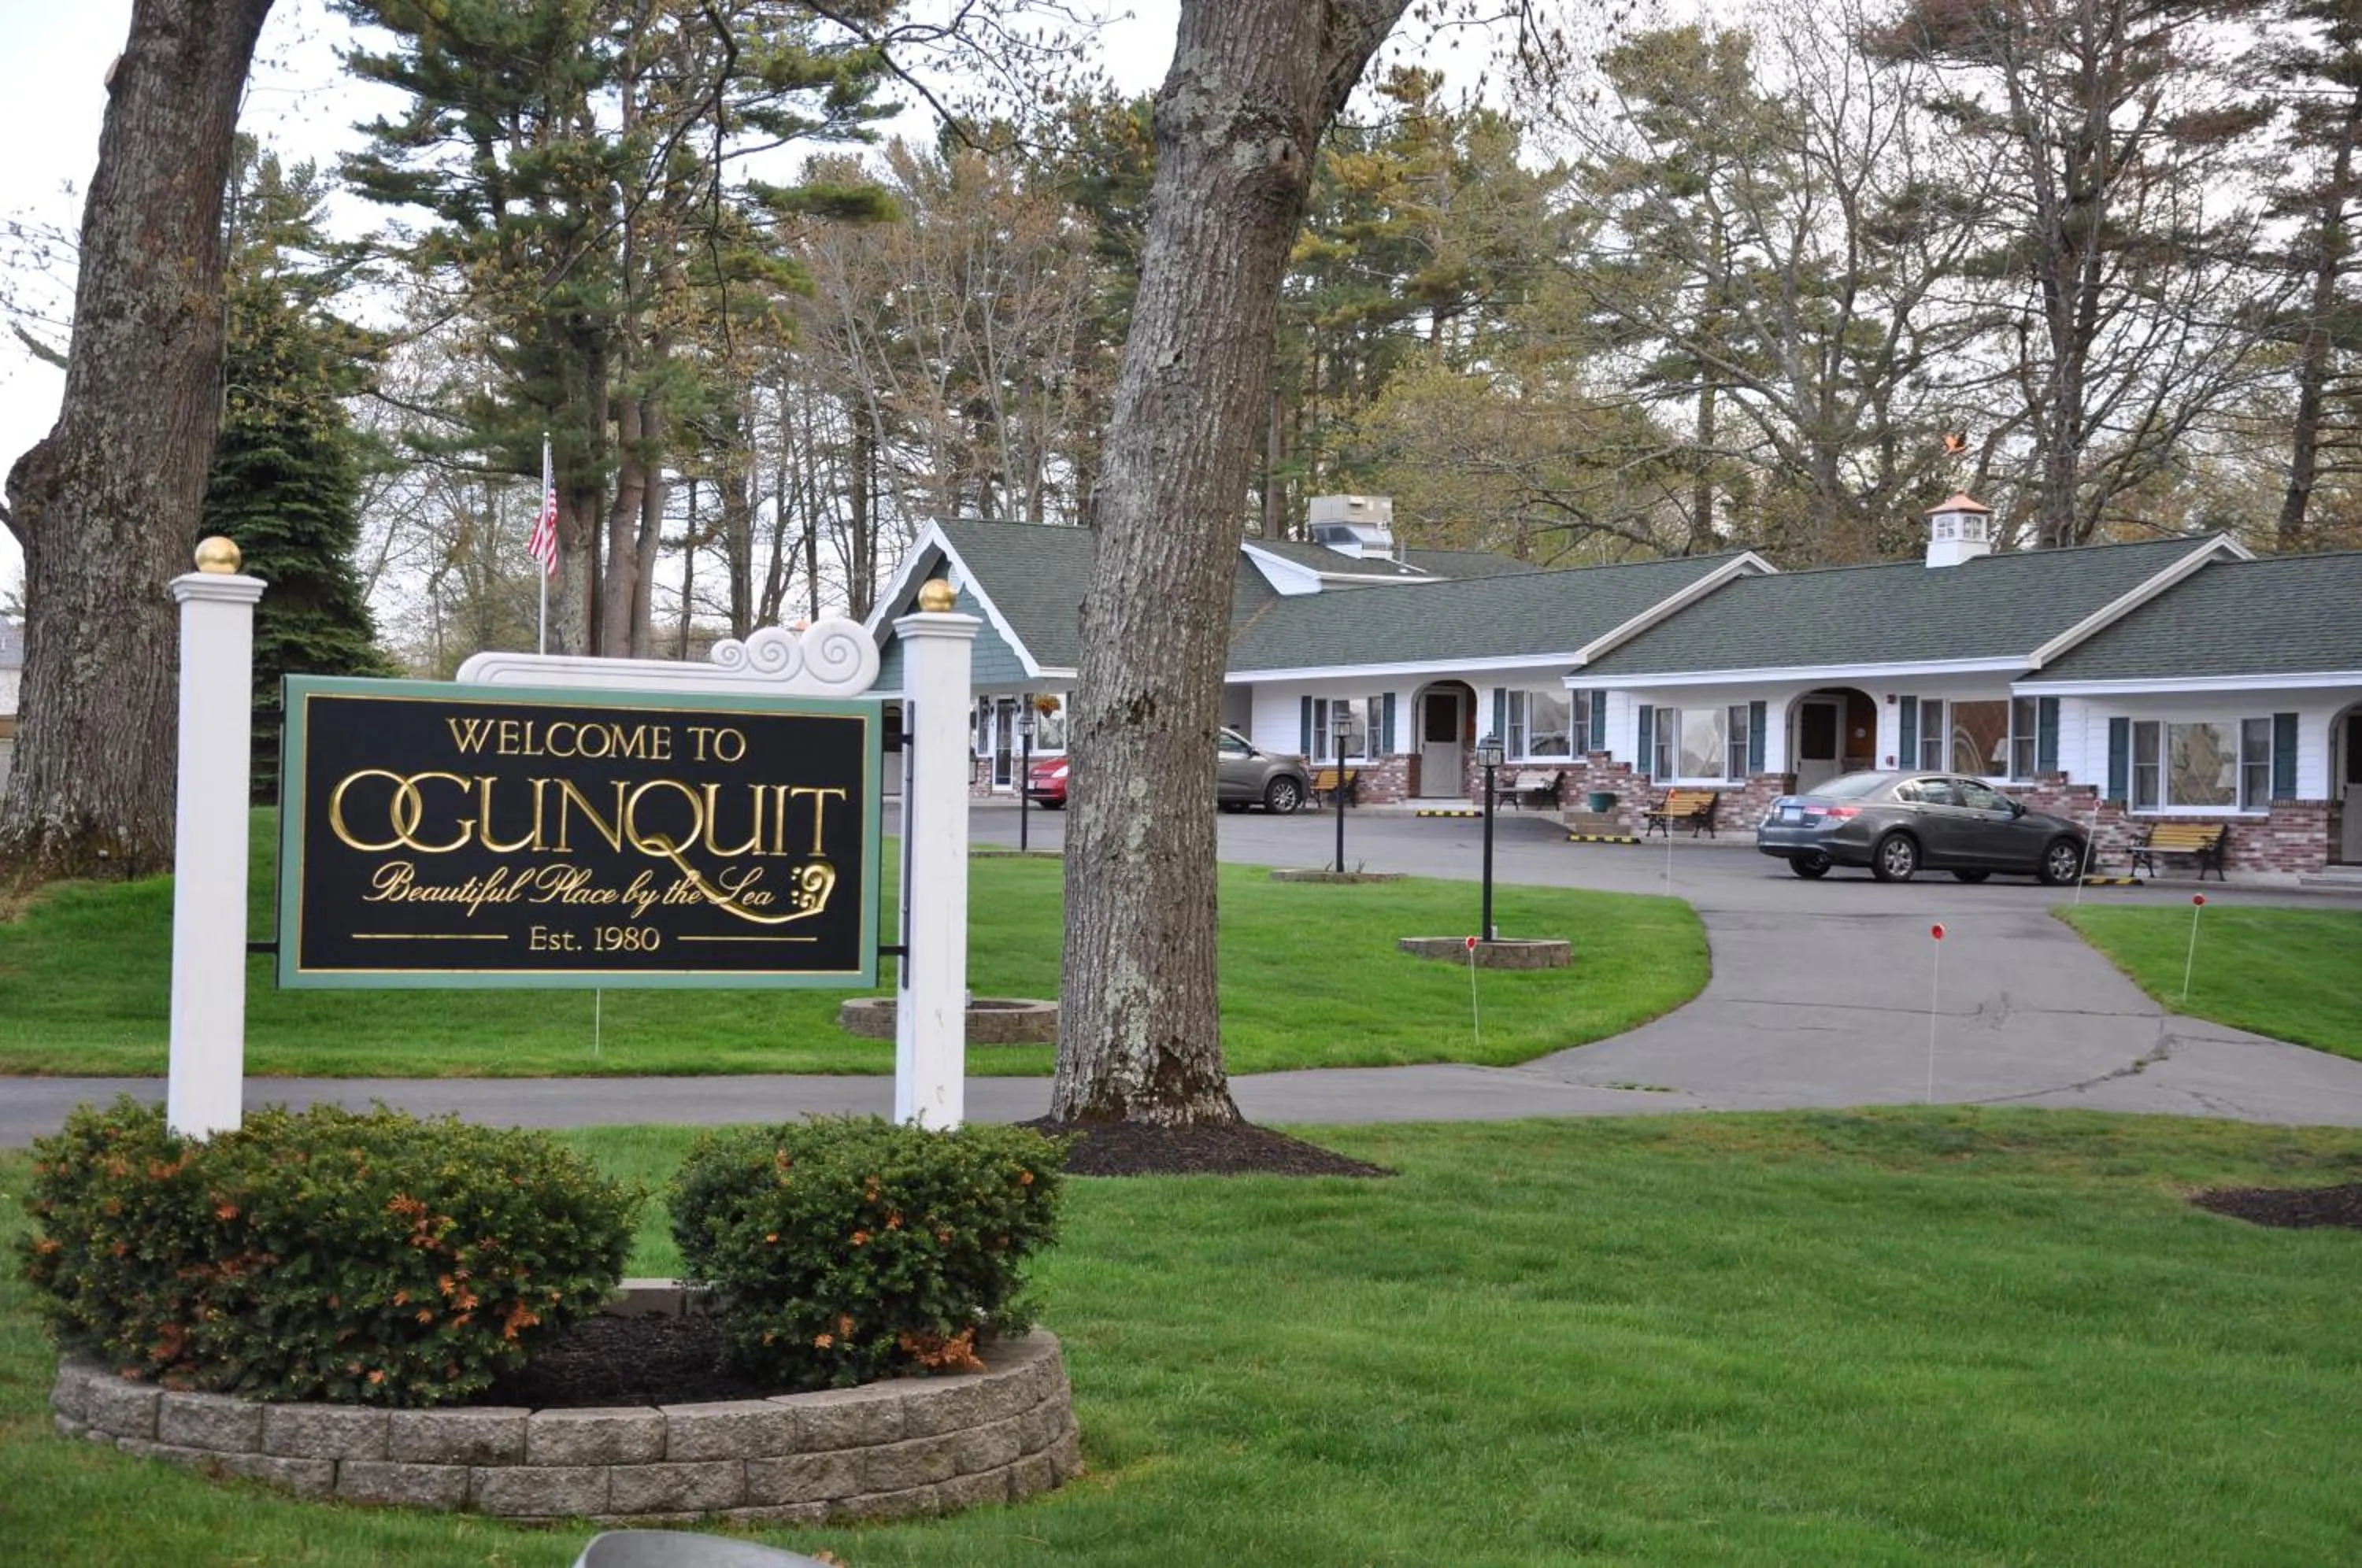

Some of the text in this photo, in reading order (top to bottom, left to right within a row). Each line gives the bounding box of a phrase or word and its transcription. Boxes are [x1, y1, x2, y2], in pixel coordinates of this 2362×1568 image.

[446, 718, 747, 763] WELCOME TO
[328, 768, 846, 860] OGUNQUIT
[362, 861, 536, 917] Beautiful
[528, 864, 620, 904] Place
[622, 871, 662, 919] by
[662, 871, 704, 906] the
[528, 926, 661, 952] Est. 1980
